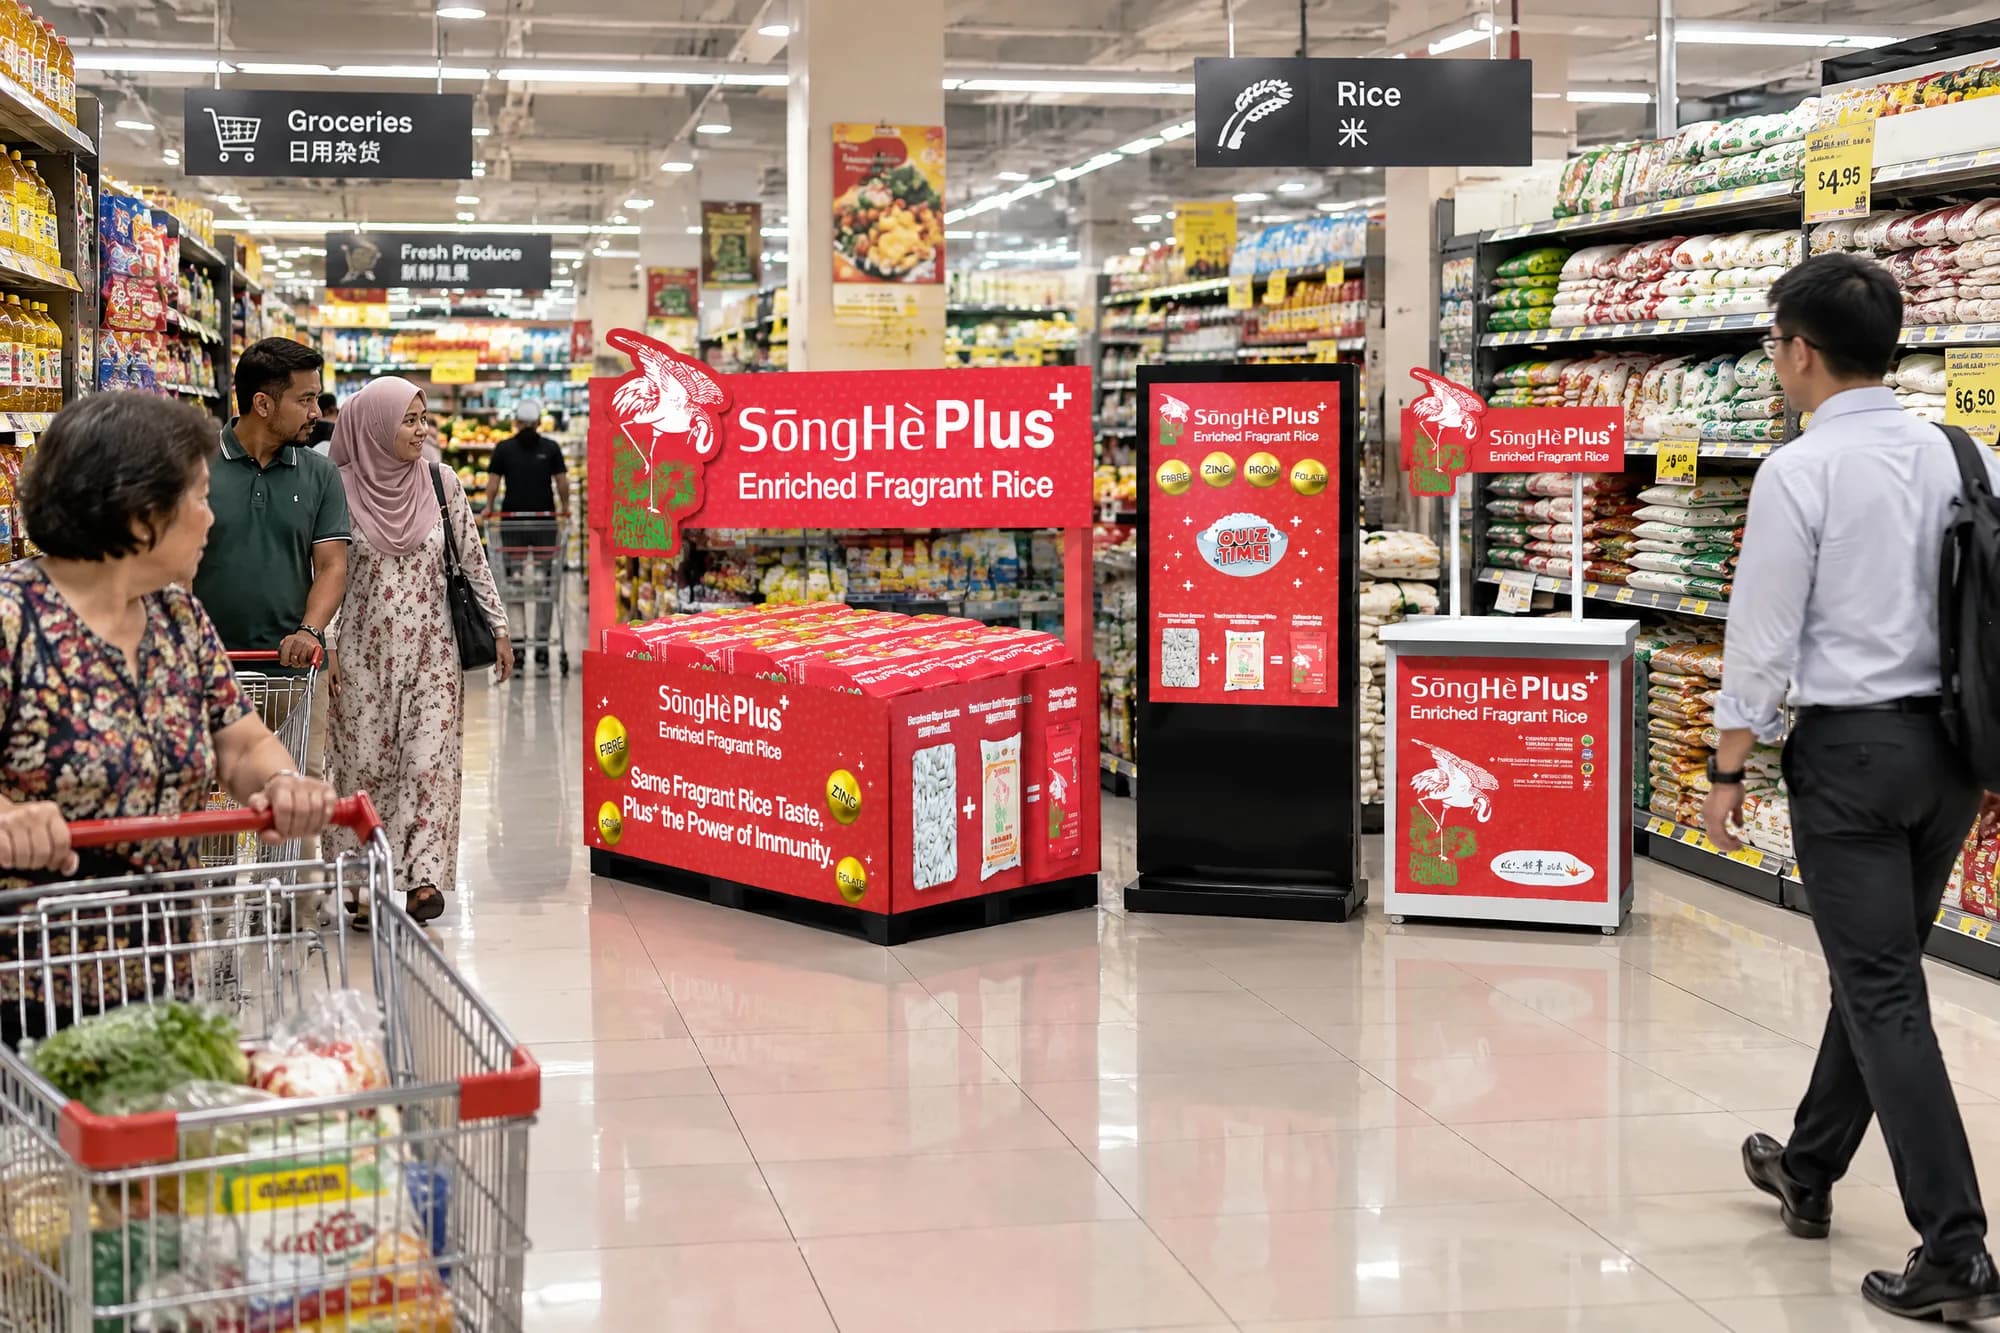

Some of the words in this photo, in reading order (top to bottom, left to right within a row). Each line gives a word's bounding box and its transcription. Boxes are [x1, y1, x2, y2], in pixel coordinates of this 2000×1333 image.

[1337, 80, 1402, 107] Rice
[287, 109, 413, 133] Groceries
[1338, 117, 1368, 148] 米
[289, 140, 381, 164] 日用杂货
[400, 243, 449, 261] Fresh
[452, 243, 522, 261] Produce
[1193, 431, 1242, 442] Enriched
[1245, 431, 1290, 444] Fragrant
[1293, 430, 1319, 442] Rice
[1205, 464, 1230, 475] ZINC
[1489, 451, 1535, 462] Enriched
[1538, 451, 1582, 464] Fragrant
[1584, 451, 1610, 462] Rice
[738, 471, 857, 500] Enriched
[866, 471, 983, 507] Fragrant
[991, 470, 1054, 499] Rice
[1217, 544, 1271, 566] TIME!
[1410, 705, 1478, 721] Enriched
[1483, 706, 1548, 725] Fragrant
[1552, 709, 1588, 724] Rice
[659, 721, 705, 745] Enriched
[706, 729, 754, 755] Fragrant
[756, 739, 782, 760] Rice
[630, 765, 671, 795] Same
[673, 775, 735, 809] Fragrant
[738, 787, 773, 817] Rice
[661, 805, 685, 831] the
[687, 810, 735, 842] Power
[737, 824, 752, 846] of
[755, 826, 835, 869] Immunity.
